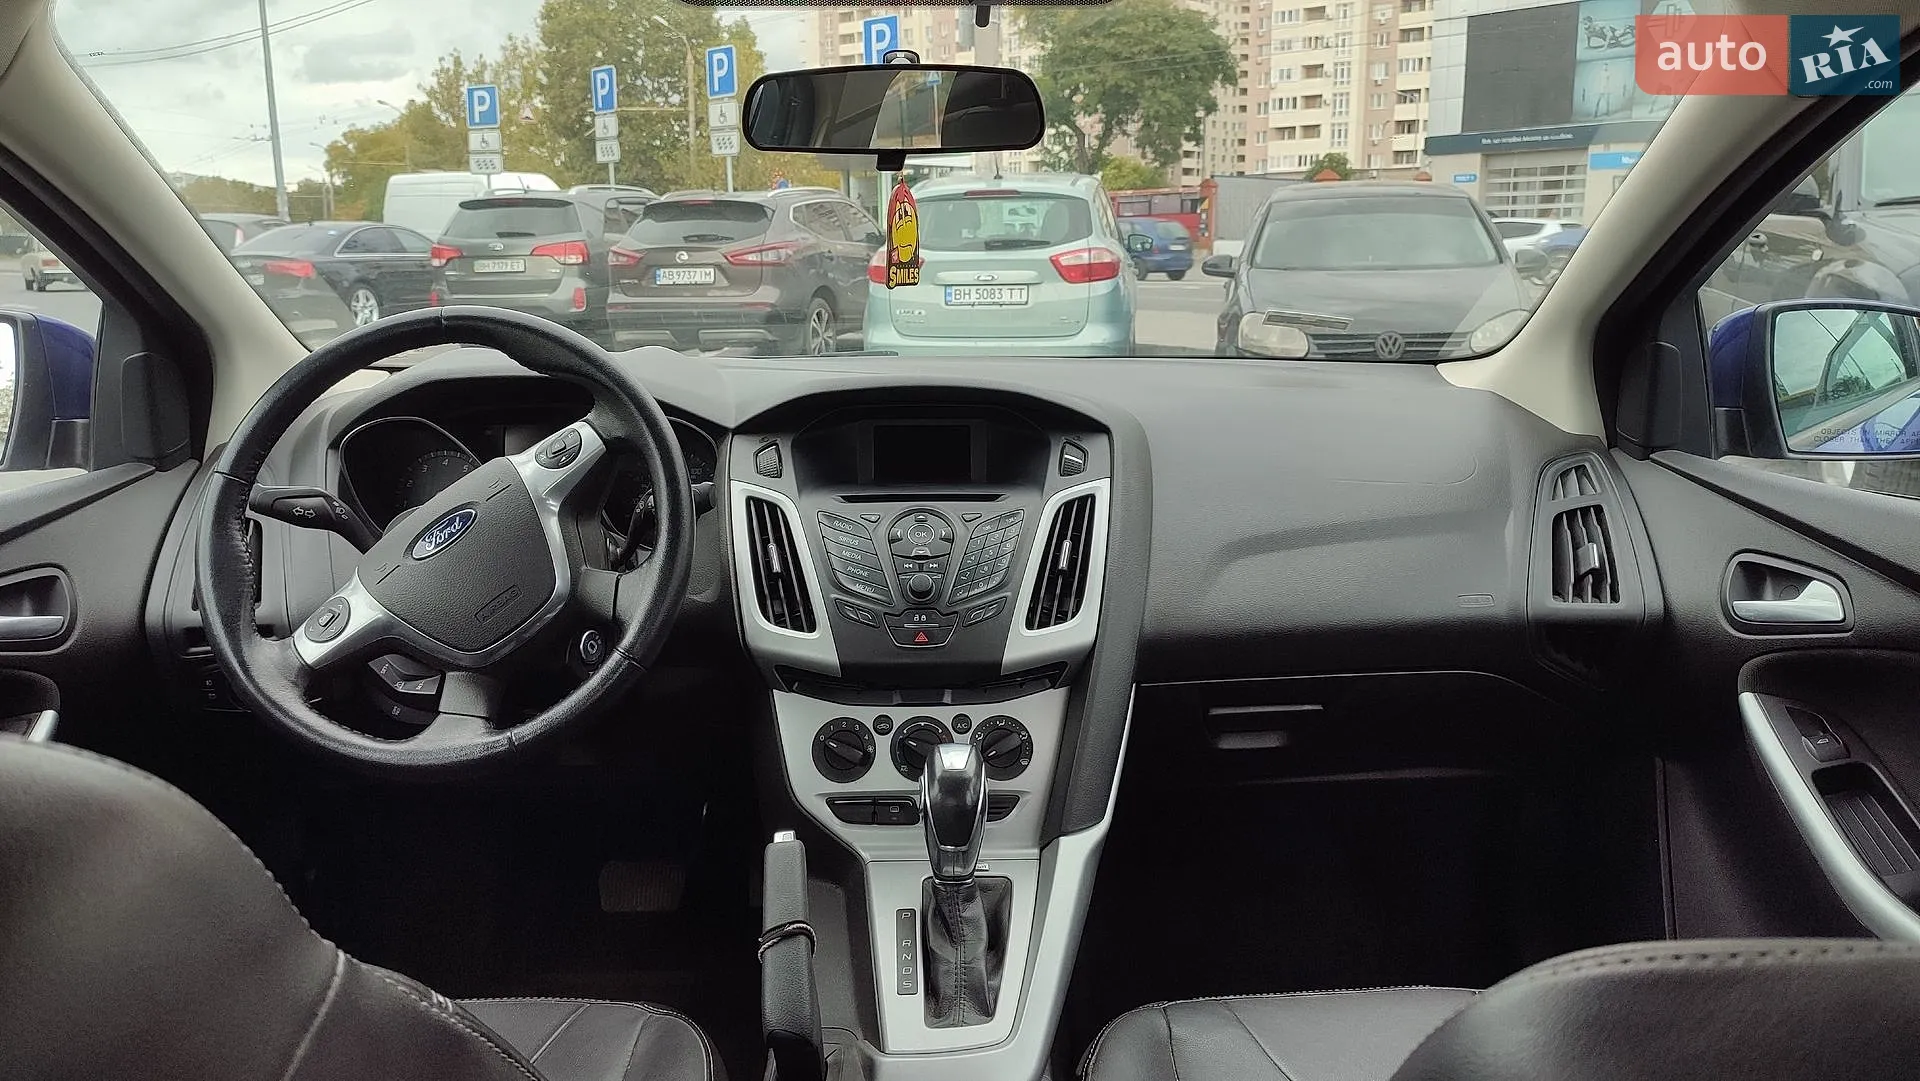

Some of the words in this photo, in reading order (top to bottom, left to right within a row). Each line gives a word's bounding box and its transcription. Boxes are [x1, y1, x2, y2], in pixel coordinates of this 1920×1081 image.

[871, 23, 891, 64] P
[713, 52, 729, 92] P
[596, 71, 610, 108] P
[473, 90, 491, 123] P
[662, 270, 674, 280] AB
[676, 270, 698, 280] 9737
[889, 266, 919, 288] SMILES
[954, 288, 972, 300] BH
[975, 288, 1003, 300] 5083
[1007, 288, 1025, 299] TT
[1875, 429, 1907, 437] MIRROR
[833, 520, 853, 531] RADIO
[425, 516, 463, 550] Ford
[842, 549, 862, 560] MEDIA
[846, 565, 870, 577] PHONE
[855, 582, 875, 593] MENU
